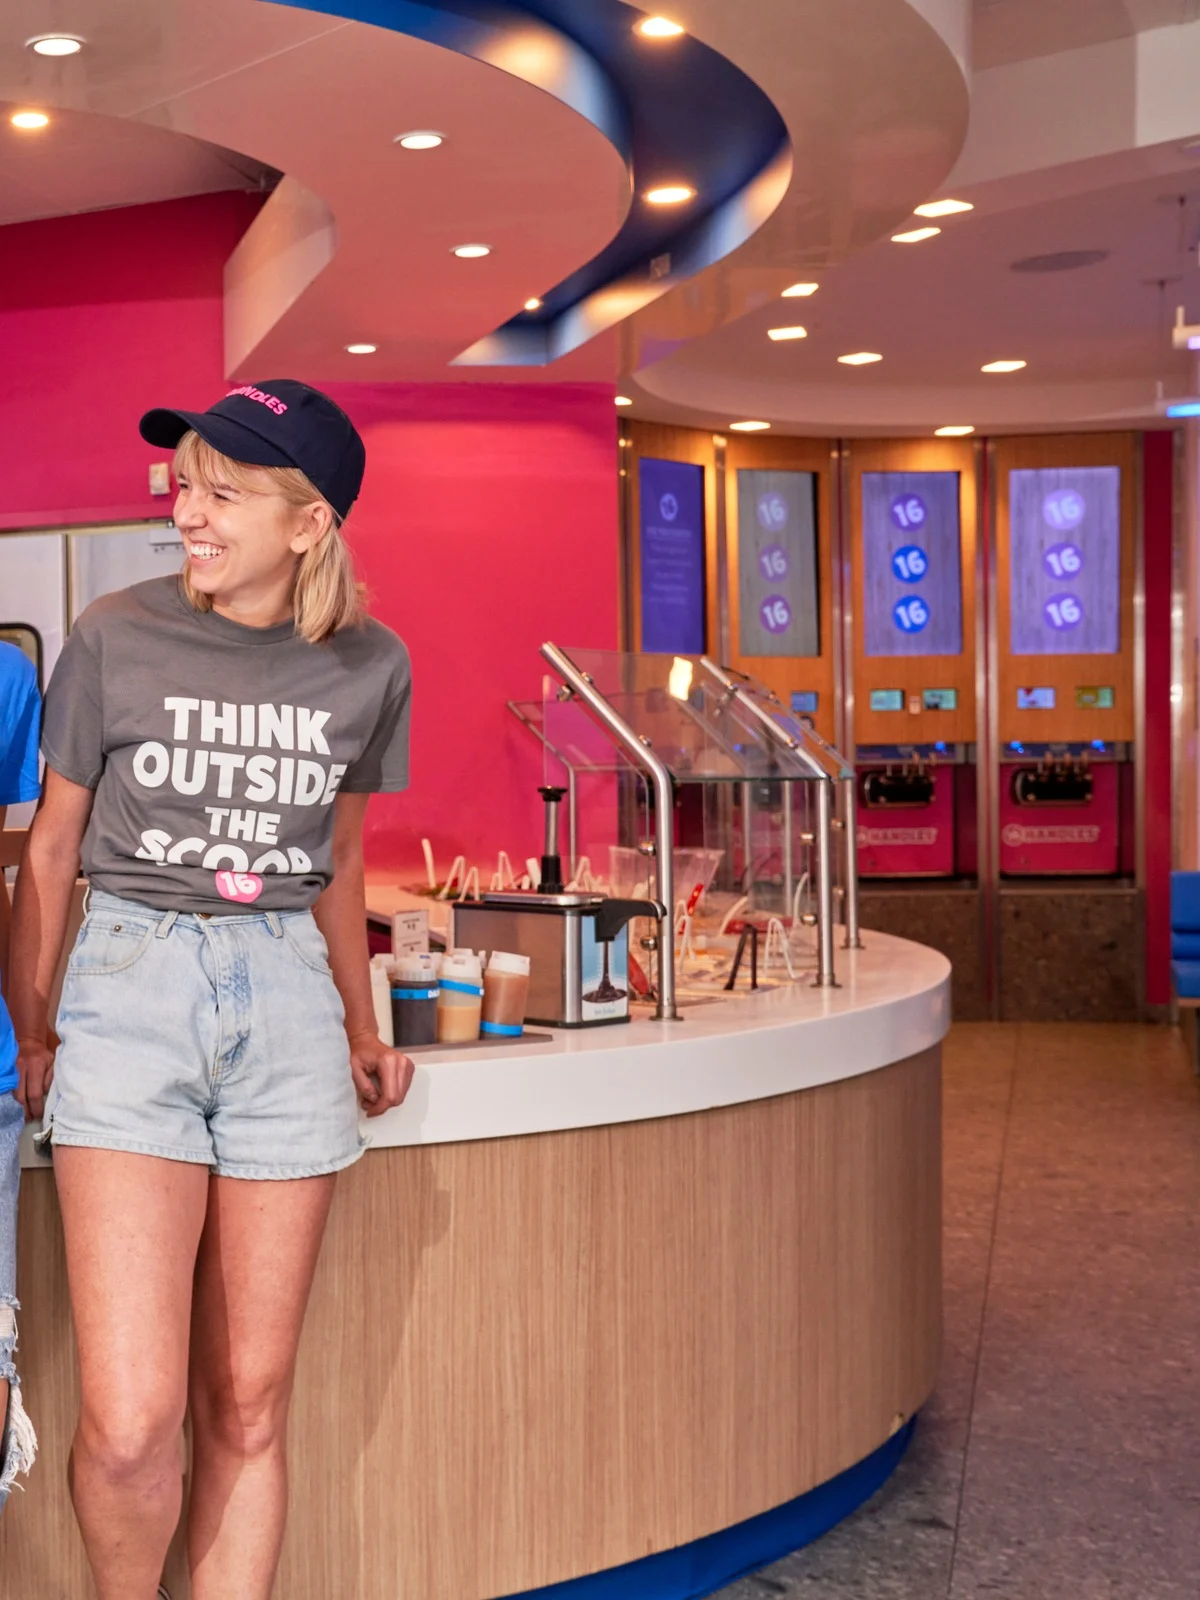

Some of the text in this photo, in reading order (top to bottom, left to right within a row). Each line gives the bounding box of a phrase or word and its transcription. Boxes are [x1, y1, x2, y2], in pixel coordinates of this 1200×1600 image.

[758, 498, 786, 526] 16
[893, 499, 925, 527] 16
[1046, 496, 1081, 525] 16
[760, 551, 788, 578] 16
[894, 551, 926, 579] 16
[1046, 548, 1081, 577] 16
[762, 600, 790, 629] 16
[895, 601, 928, 629] 16
[1046, 598, 1081, 627] 16
[164, 696, 332, 756] THINK
[132, 741, 348, 806] OUTSIDE
[204, 806, 281, 845] THE
[220, 871, 258, 897] 16
